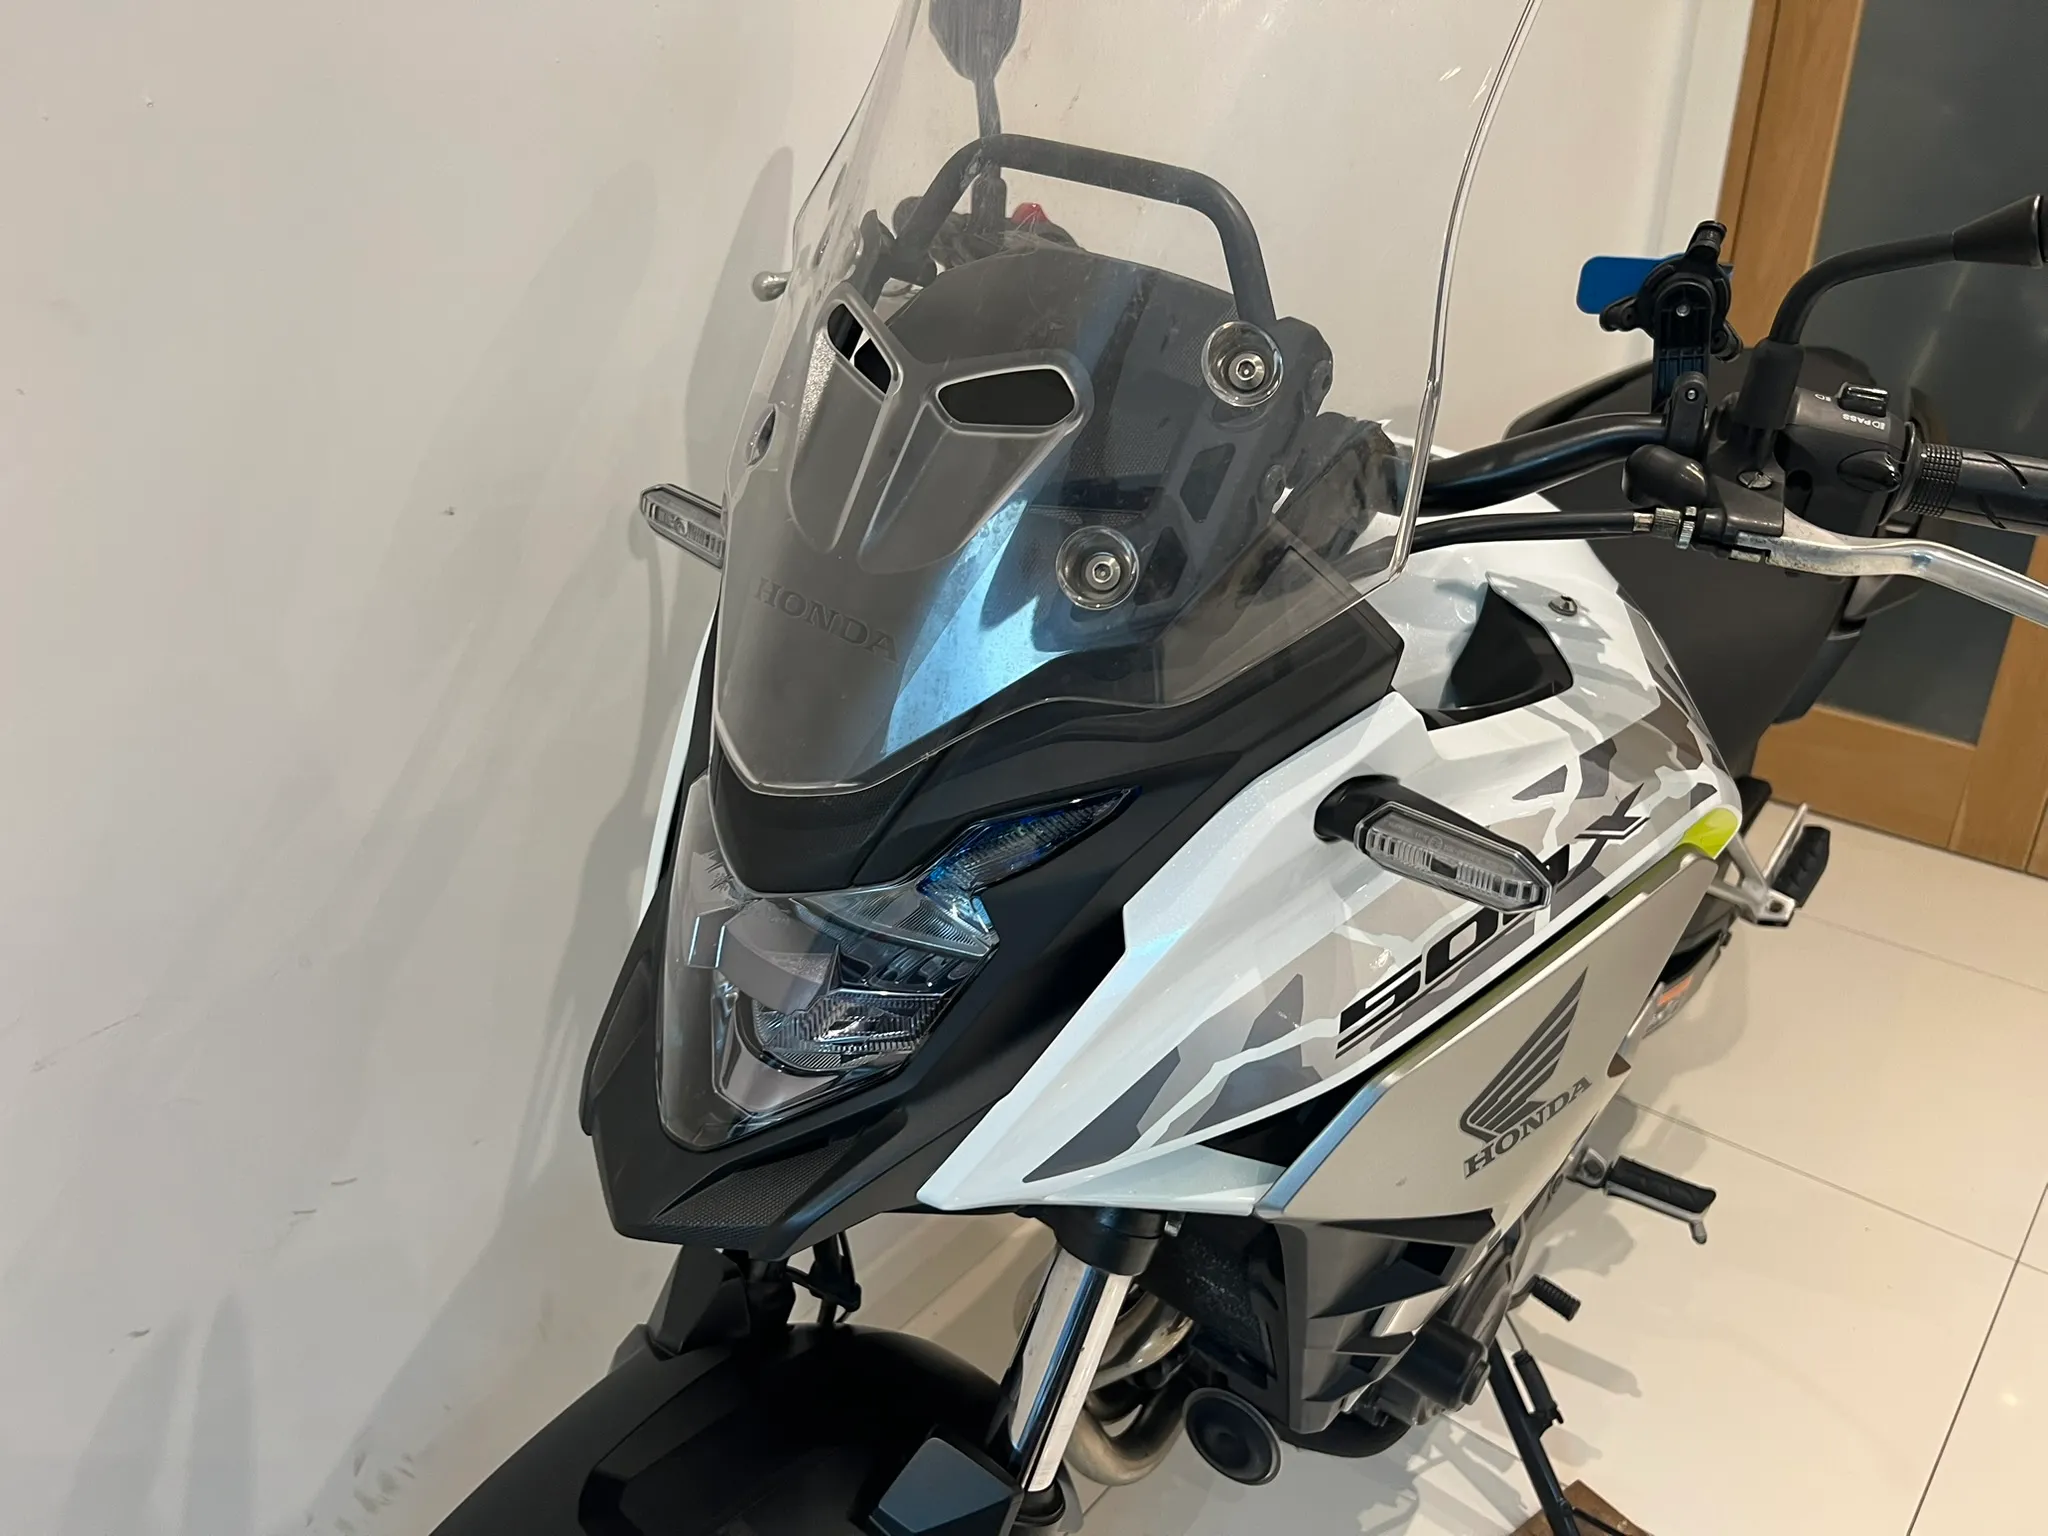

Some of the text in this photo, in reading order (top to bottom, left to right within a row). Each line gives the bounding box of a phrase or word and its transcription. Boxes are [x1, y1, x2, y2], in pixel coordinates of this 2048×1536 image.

[1842, 413, 1871, 426] PASS
[755, 576, 898, 663] HONDA
[1464, 1076, 1593, 1180] HONDA
